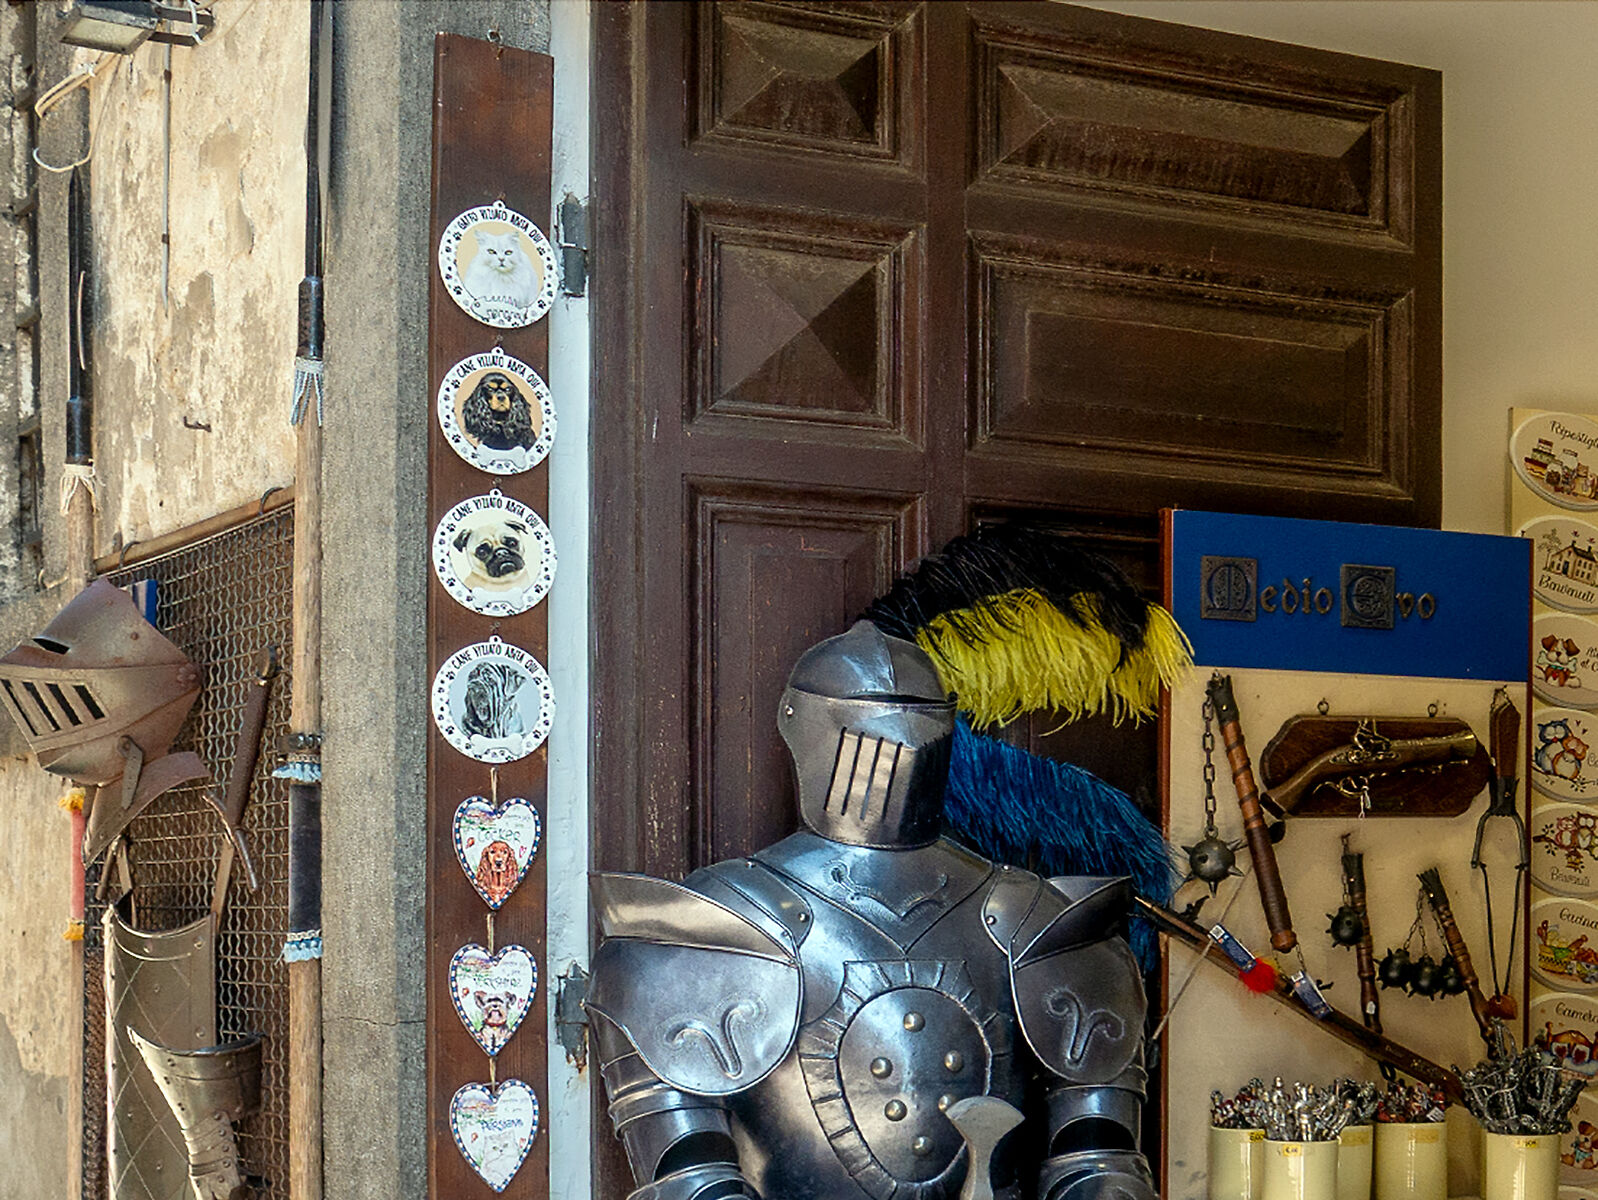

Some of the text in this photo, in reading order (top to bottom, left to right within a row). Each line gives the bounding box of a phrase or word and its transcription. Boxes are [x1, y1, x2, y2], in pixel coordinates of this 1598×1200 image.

[456, 359, 477, 378] CANE
[451, 503, 473, 522] CANE
[1202, 558, 1436, 627] Medio Evo
[451, 650, 473, 670] CANE
